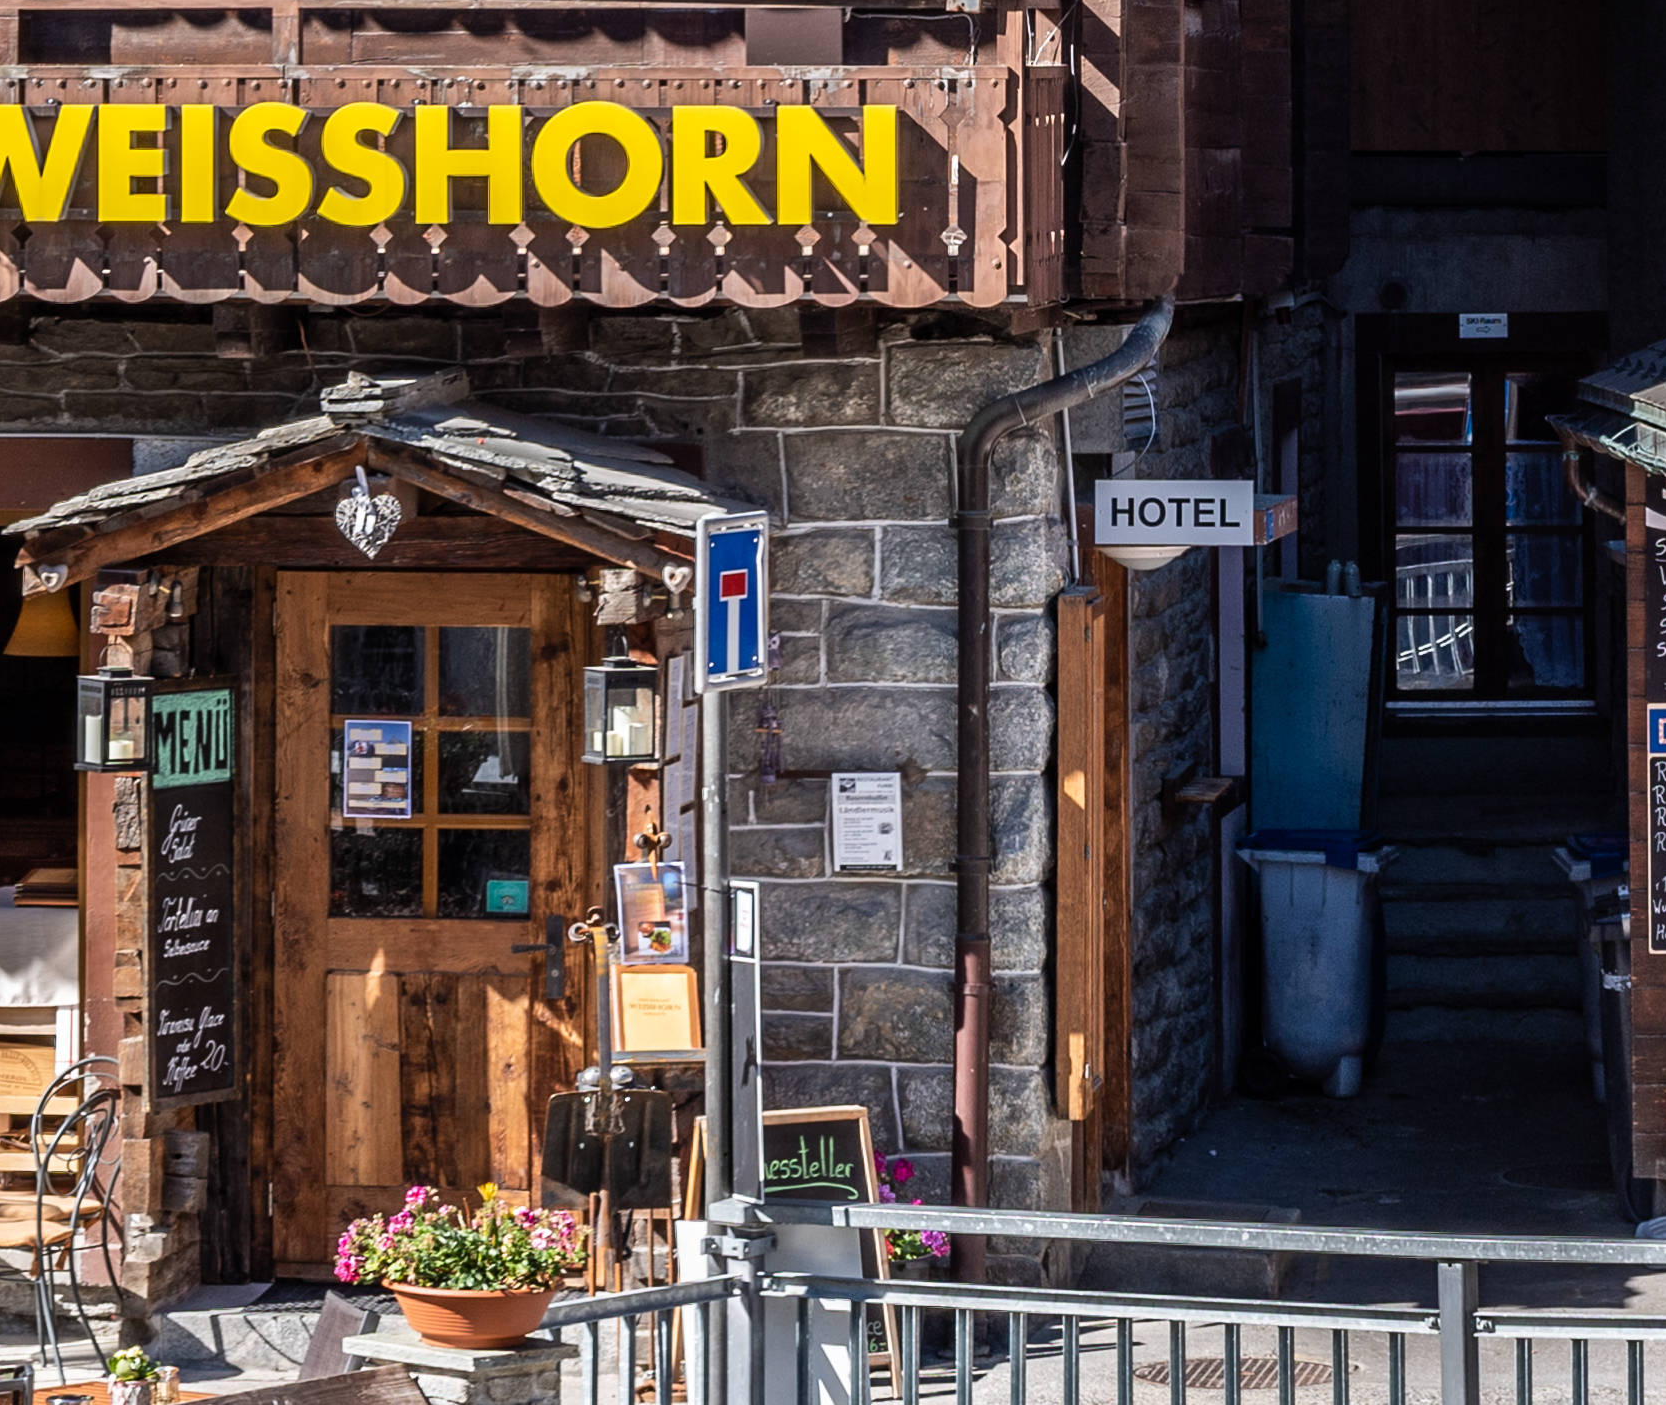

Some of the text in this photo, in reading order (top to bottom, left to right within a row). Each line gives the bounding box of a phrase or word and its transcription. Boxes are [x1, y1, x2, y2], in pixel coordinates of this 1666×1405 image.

[1110, 497, 1241, 528] HOTEL
[154, 697, 229, 775] MENÜ
[163, 1056, 199, 1094] Kaffee
[764, 1134, 855, 1180] essteller
